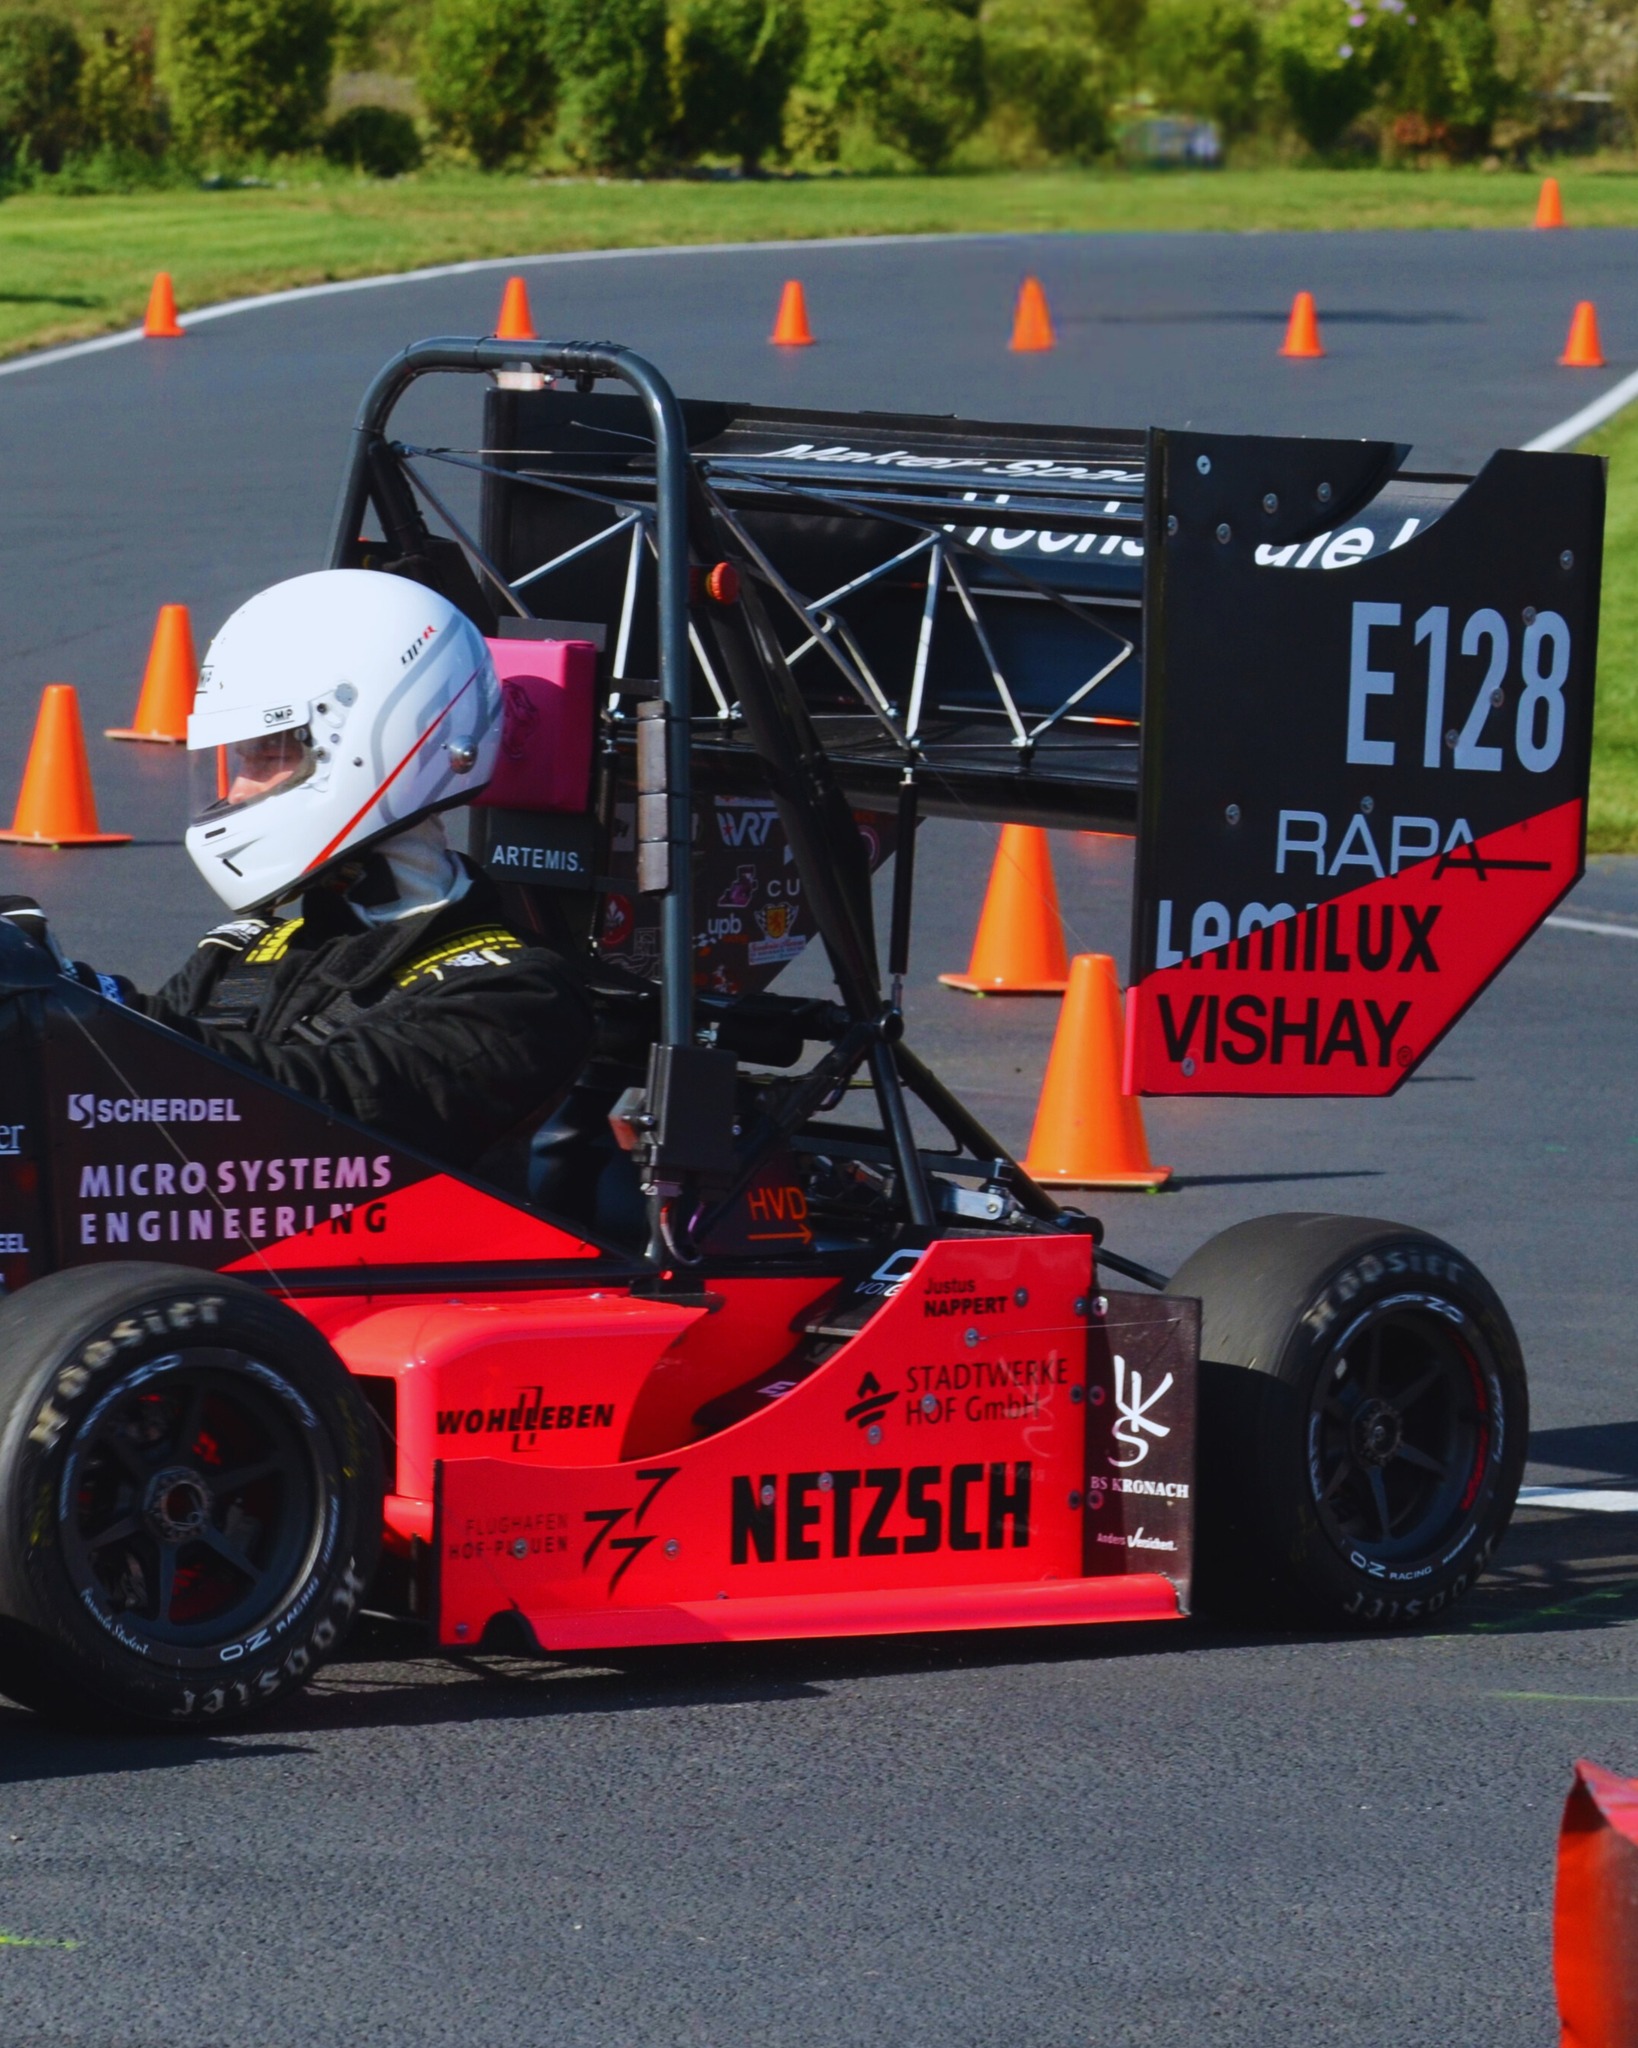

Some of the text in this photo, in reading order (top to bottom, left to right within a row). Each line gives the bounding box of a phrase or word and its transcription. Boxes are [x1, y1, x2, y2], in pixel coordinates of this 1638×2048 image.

[1346, 601, 1571, 773] E128
[1275, 809, 1551, 882] RAPA
[1157, 993, 1412, 1068] VISHAY
[96, 1098, 241, 1124] SCHERDEL
[746, 1185, 808, 1222] HVD
[80, 1202, 388, 1245] ENGINEERING
[924, 1278, 976, 1295] Justus
[924, 1296, 1008, 1318] NAPPERT
[906, 1357, 1068, 1395] STADTWERKE
[906, 1394, 1040, 1427] HOF GmbH
[1111, 1478, 1190, 1499] KRONACH
[465, 1512, 569, 1536] FLUGHAFEN
[731, 1461, 1032, 1565] NETZSCH
[449, 1535, 569, 1560] HOF-PLUEN
[1388, 1565, 1433, 1581] RACING
